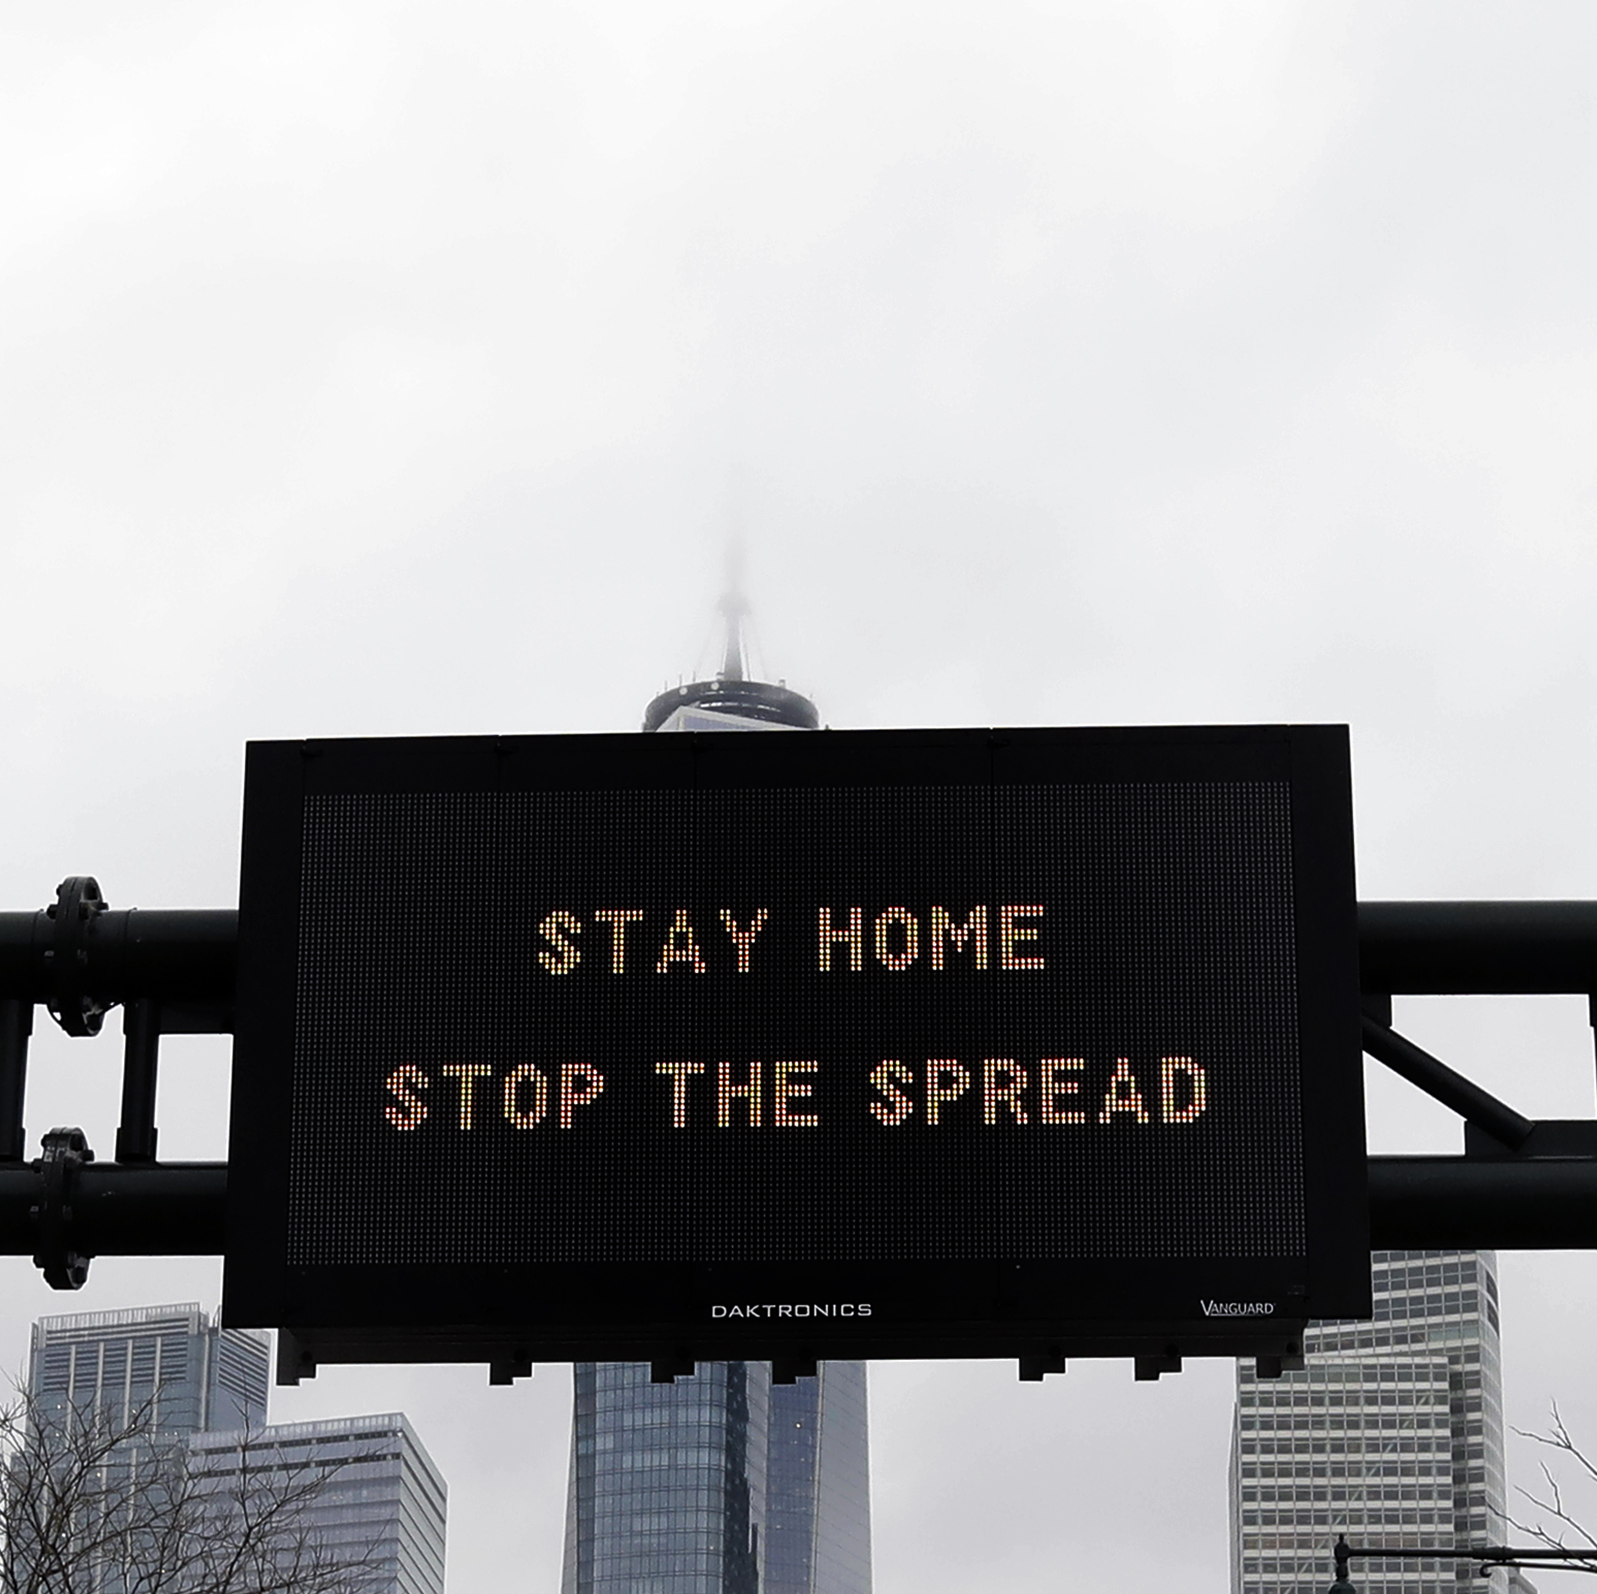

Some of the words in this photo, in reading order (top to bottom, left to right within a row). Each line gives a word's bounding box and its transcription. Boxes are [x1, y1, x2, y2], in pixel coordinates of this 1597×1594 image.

[538, 908, 769, 976] STAY
[818, 904, 1046, 972] HOME
[384, 1062, 605, 1131] STOP
[655, 1060, 820, 1128] THE
[869, 1055, 1207, 1126] SPREAD
[711, 1303, 873, 1319] DAKTRONICS
[1200, 1299, 1274, 1317] VANGUARD
